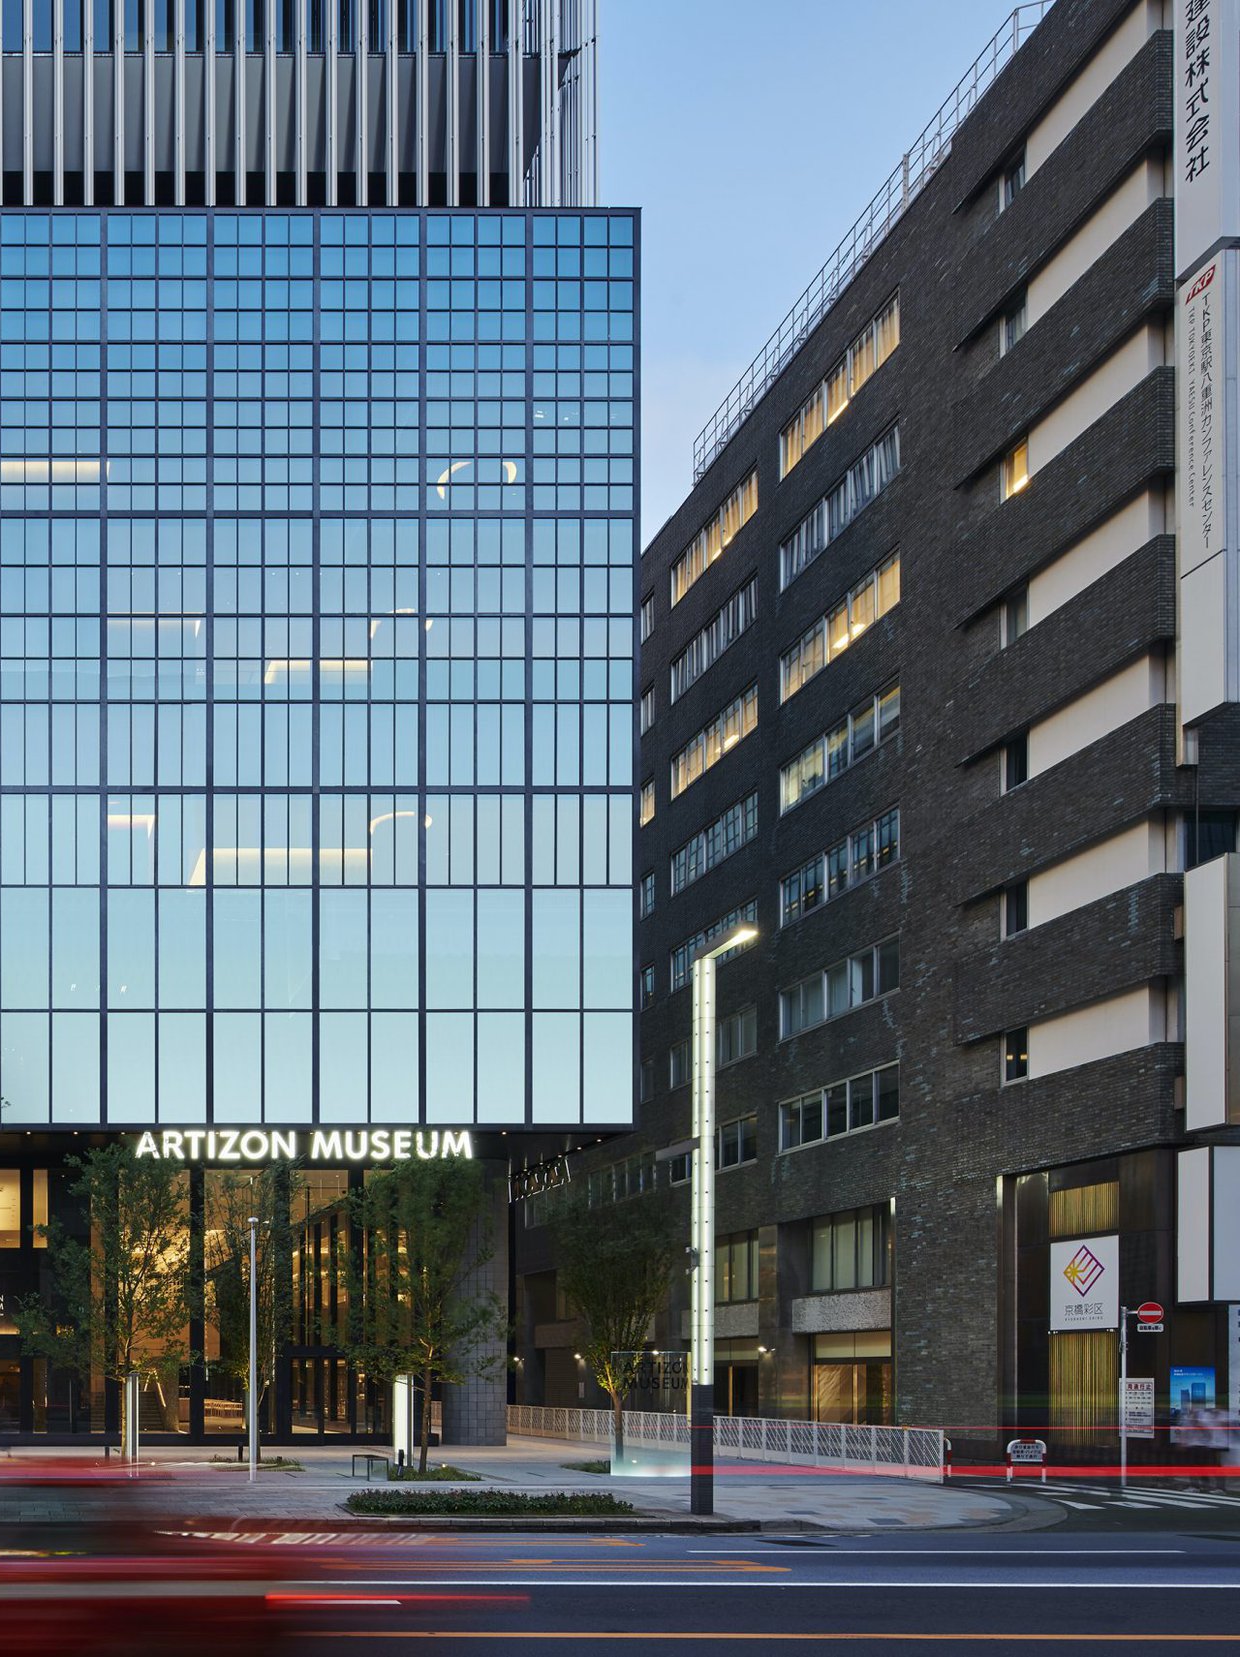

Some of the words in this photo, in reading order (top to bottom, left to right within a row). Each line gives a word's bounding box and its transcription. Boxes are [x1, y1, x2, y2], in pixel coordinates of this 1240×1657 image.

[1187, 265, 1215, 303] TKP
[1188, 411, 1196, 471] Conference
[135, 1130, 296, 1160] ARTIZON
[311, 1130, 473, 1160] MUSEUM
